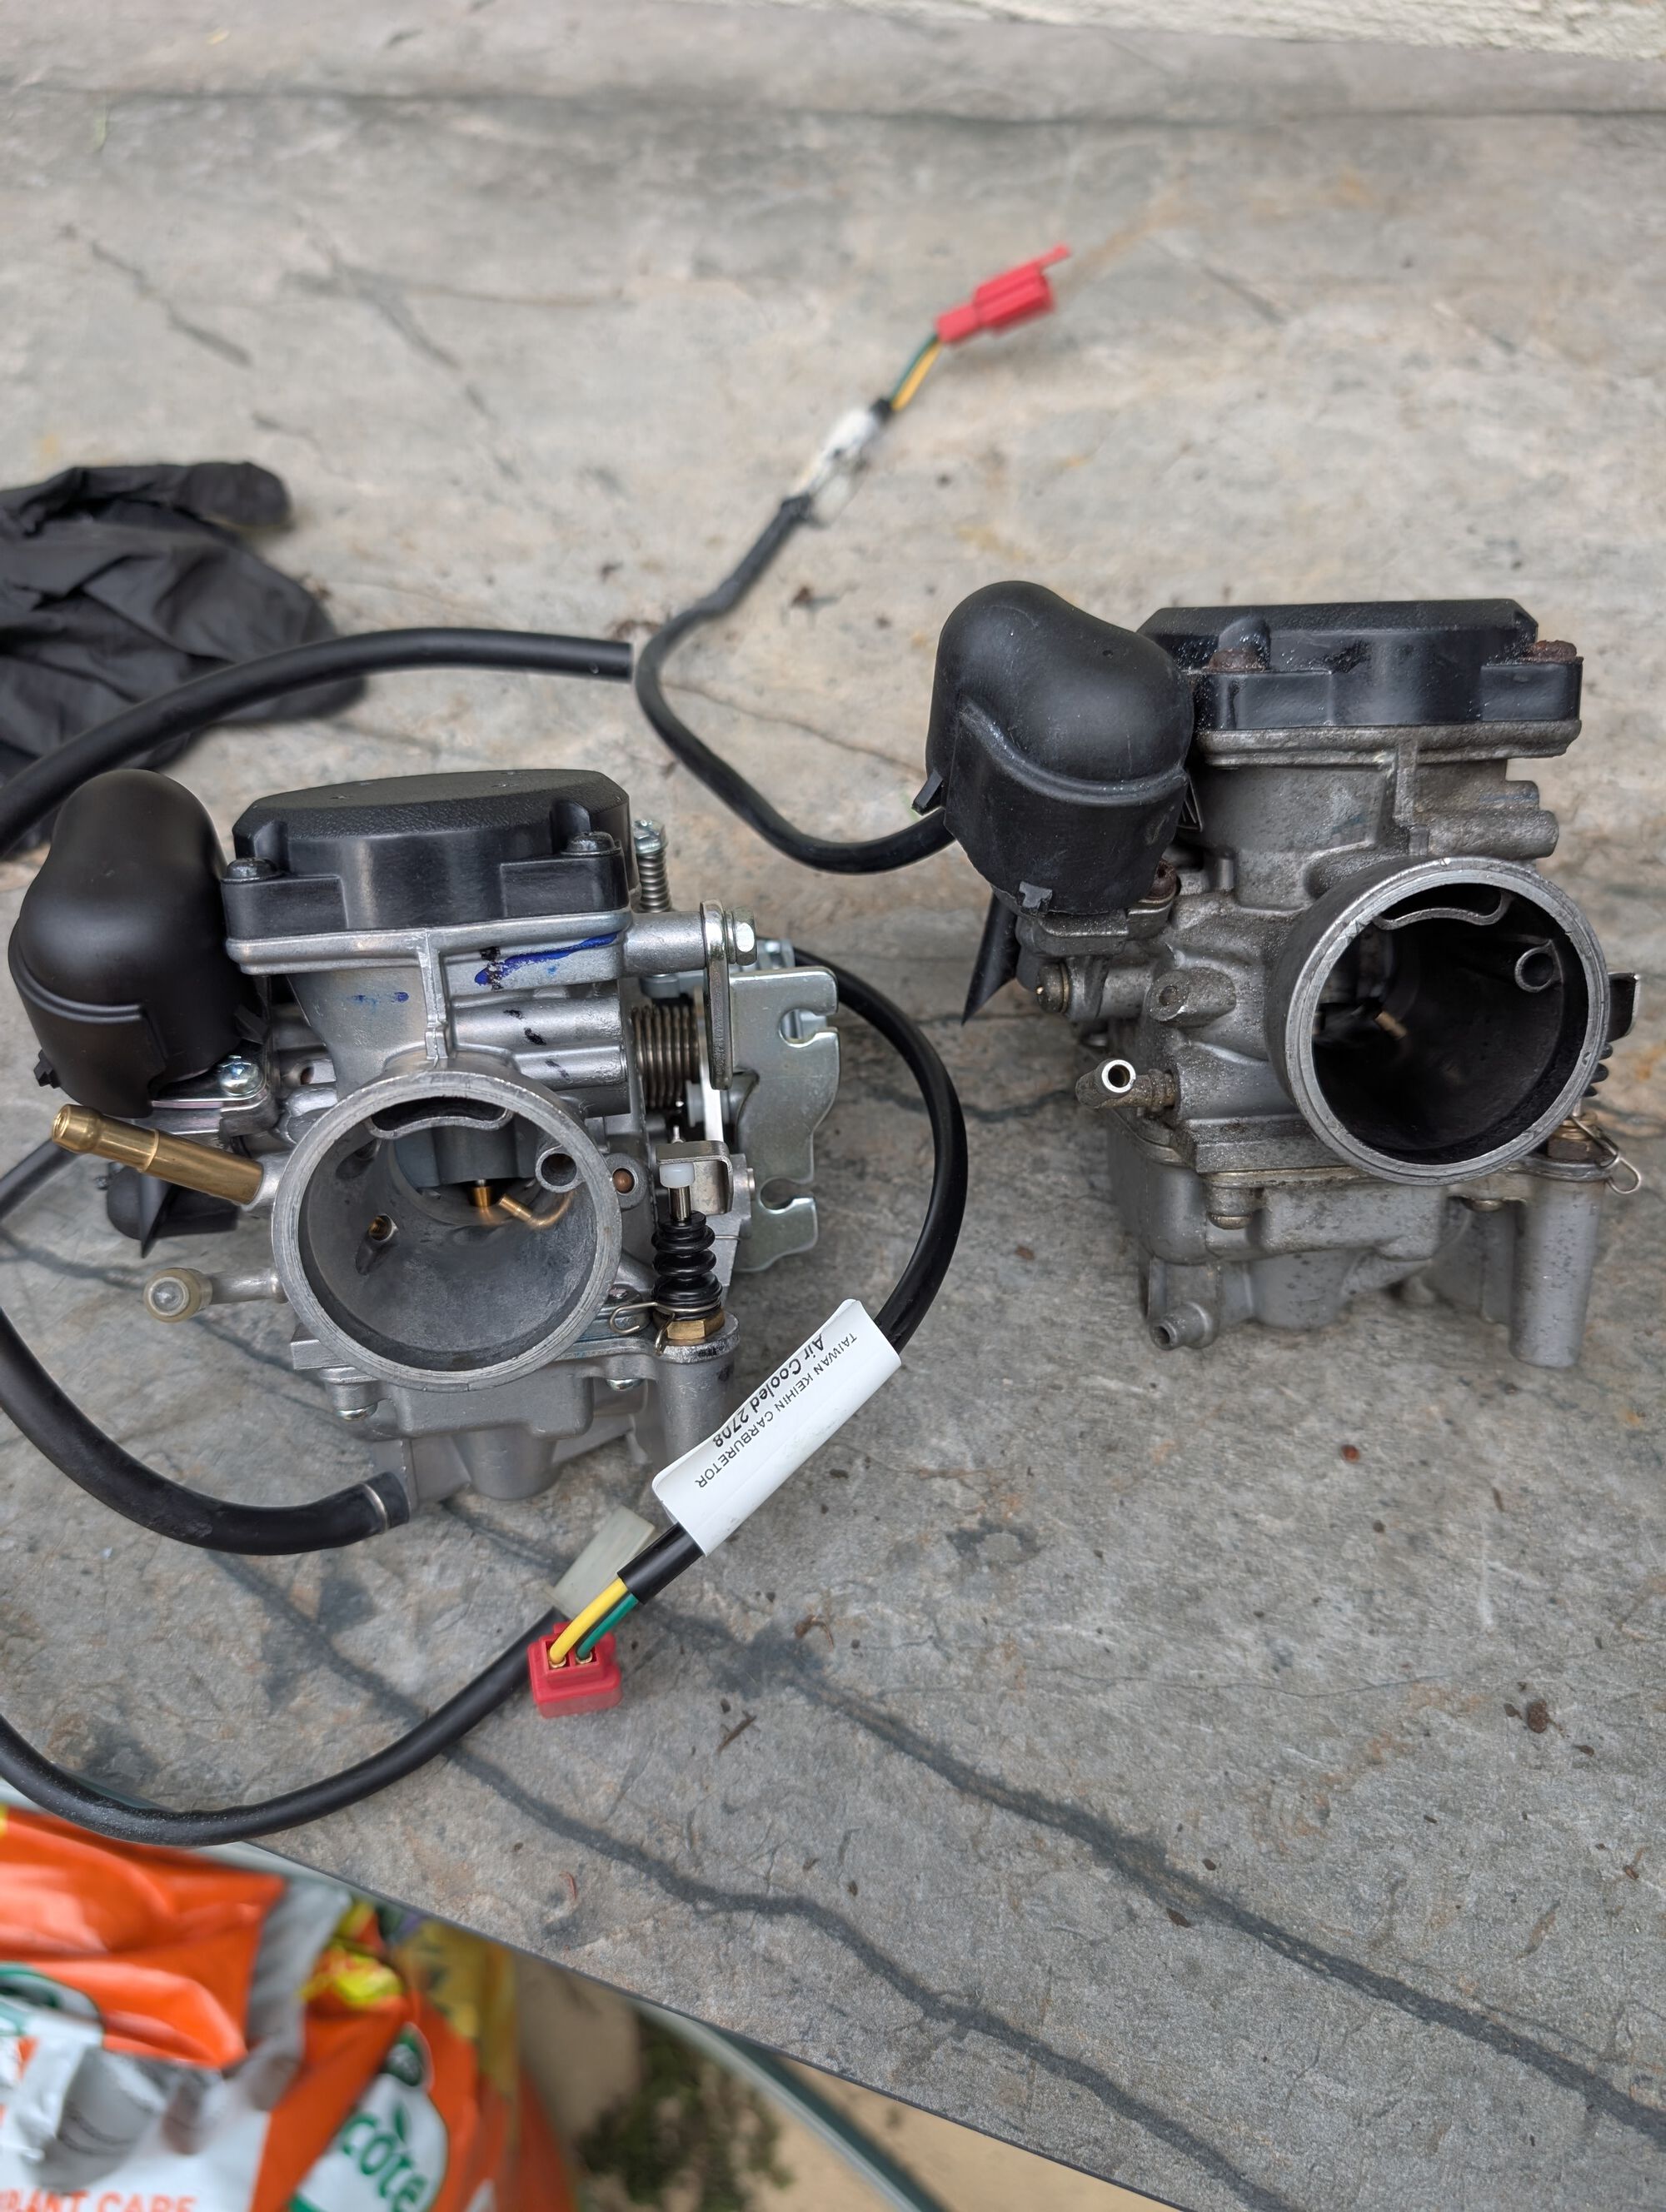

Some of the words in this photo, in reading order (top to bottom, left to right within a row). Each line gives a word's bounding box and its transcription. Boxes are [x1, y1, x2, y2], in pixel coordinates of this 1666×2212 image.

[804, 1333, 826, 1362] Air
[812, 1332, 858, 1376] TAIWAN
[749, 1358, 802, 1413] Cooled
[774, 1373, 814, 1413] KEIHIN
[695, 1410, 775, 1488] CARBURETOR
[712, 1408, 750, 1448] 2708
